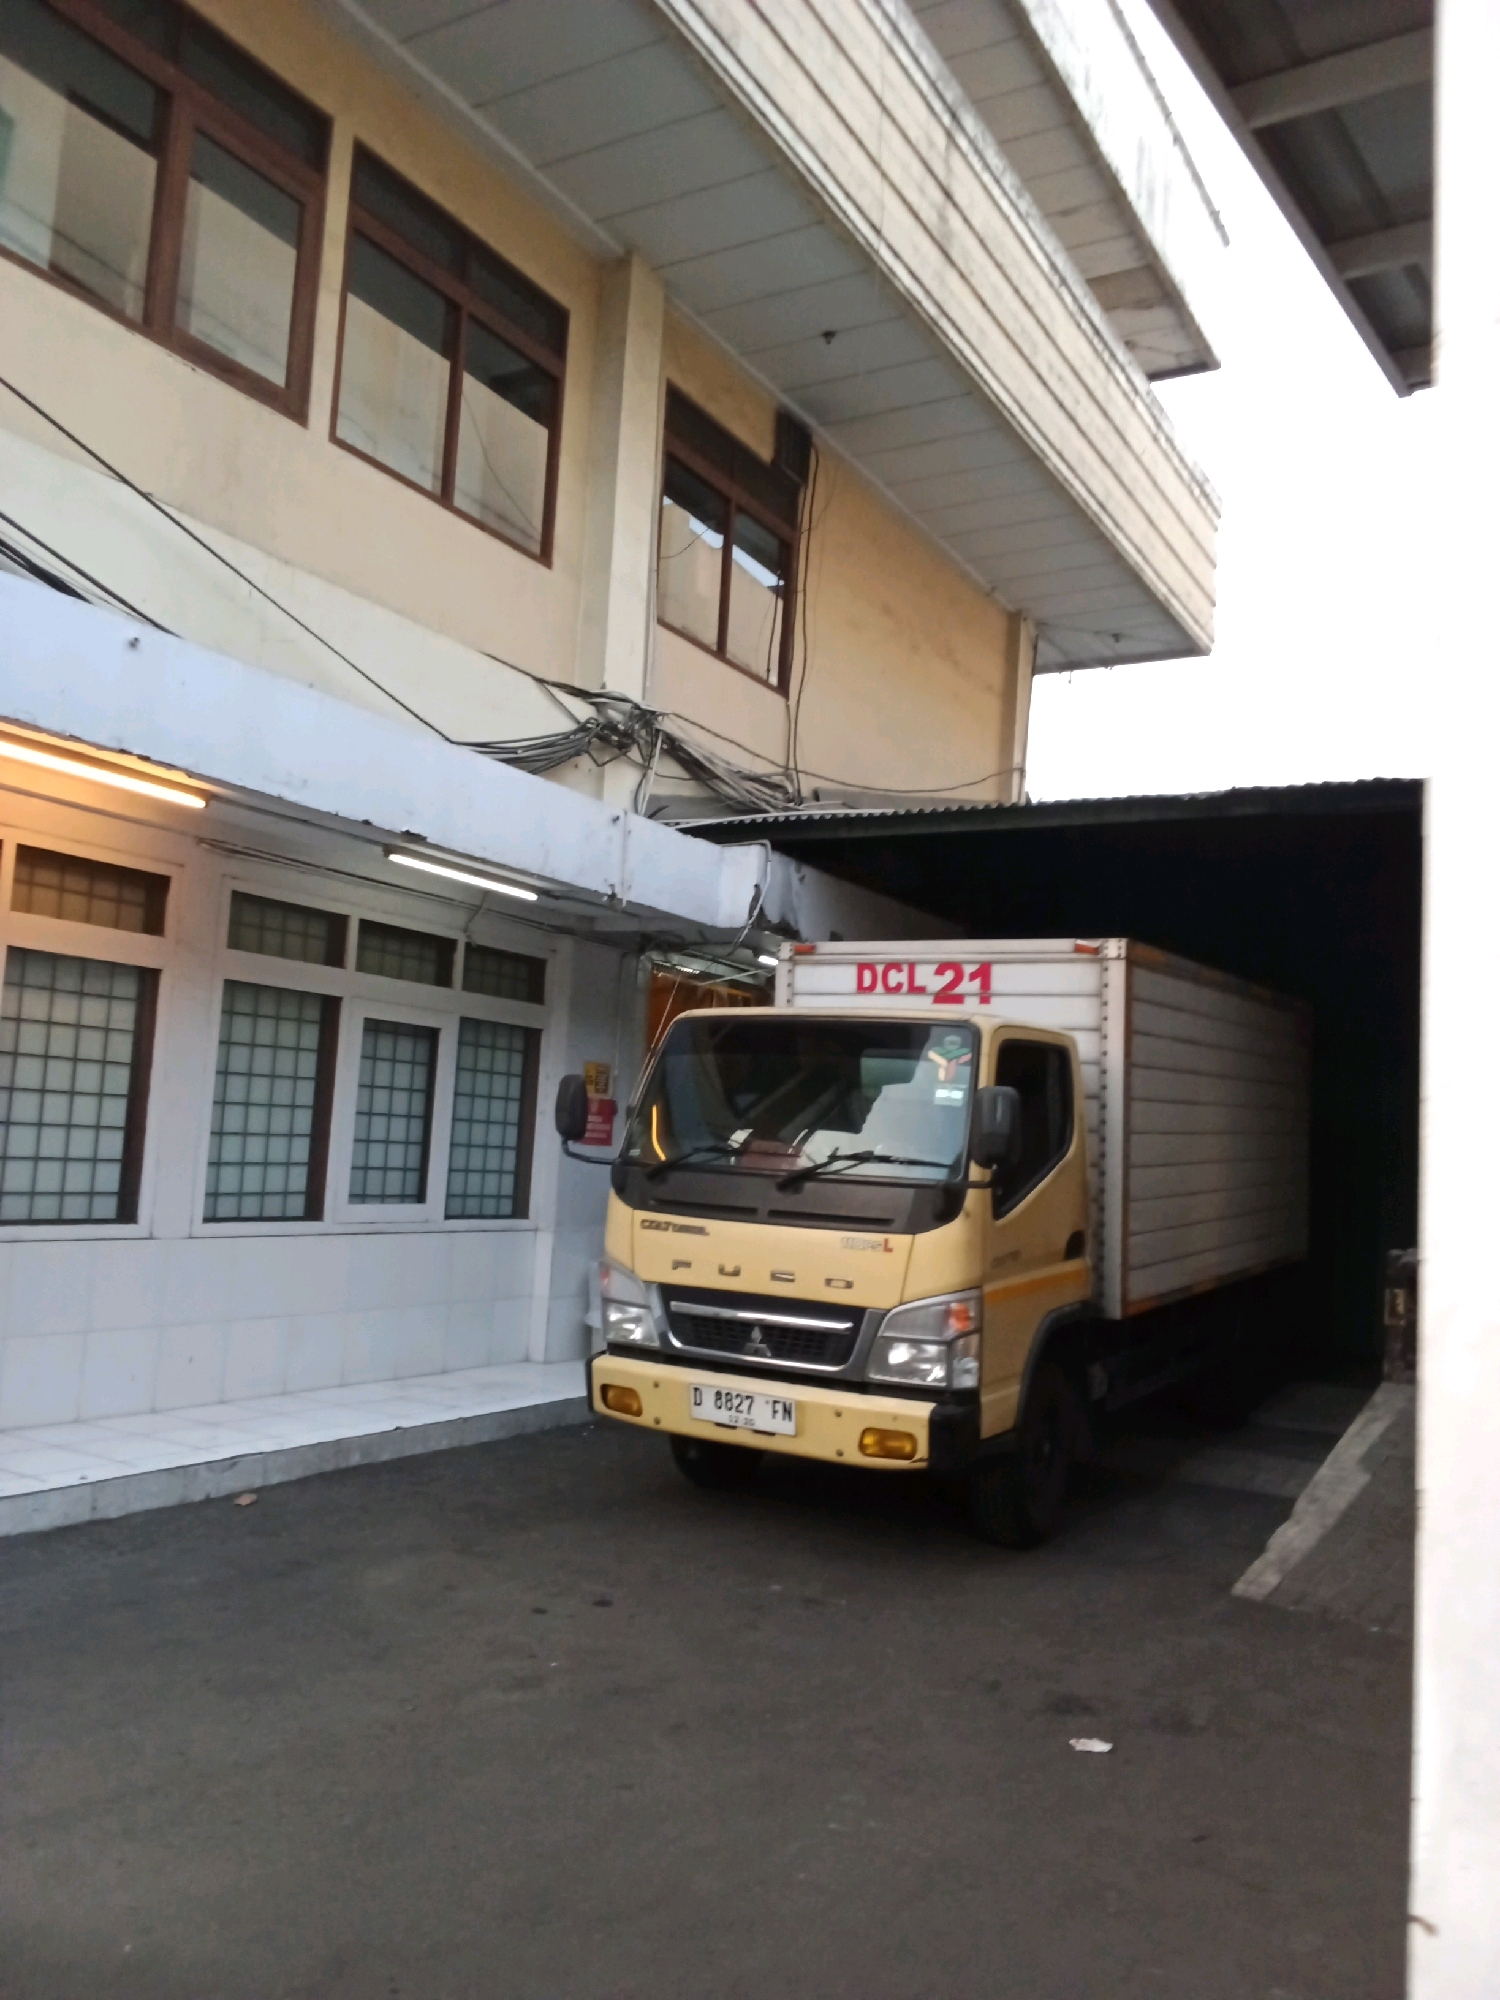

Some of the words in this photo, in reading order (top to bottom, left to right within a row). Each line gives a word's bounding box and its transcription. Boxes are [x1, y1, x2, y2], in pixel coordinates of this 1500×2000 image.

[856, 961, 927, 995] DCL
[932, 961, 991, 1005] 21
[693, 1387, 702, 1406] D
[714, 1390, 754, 1415] 8827
[772, 1400, 792, 1422] FN
